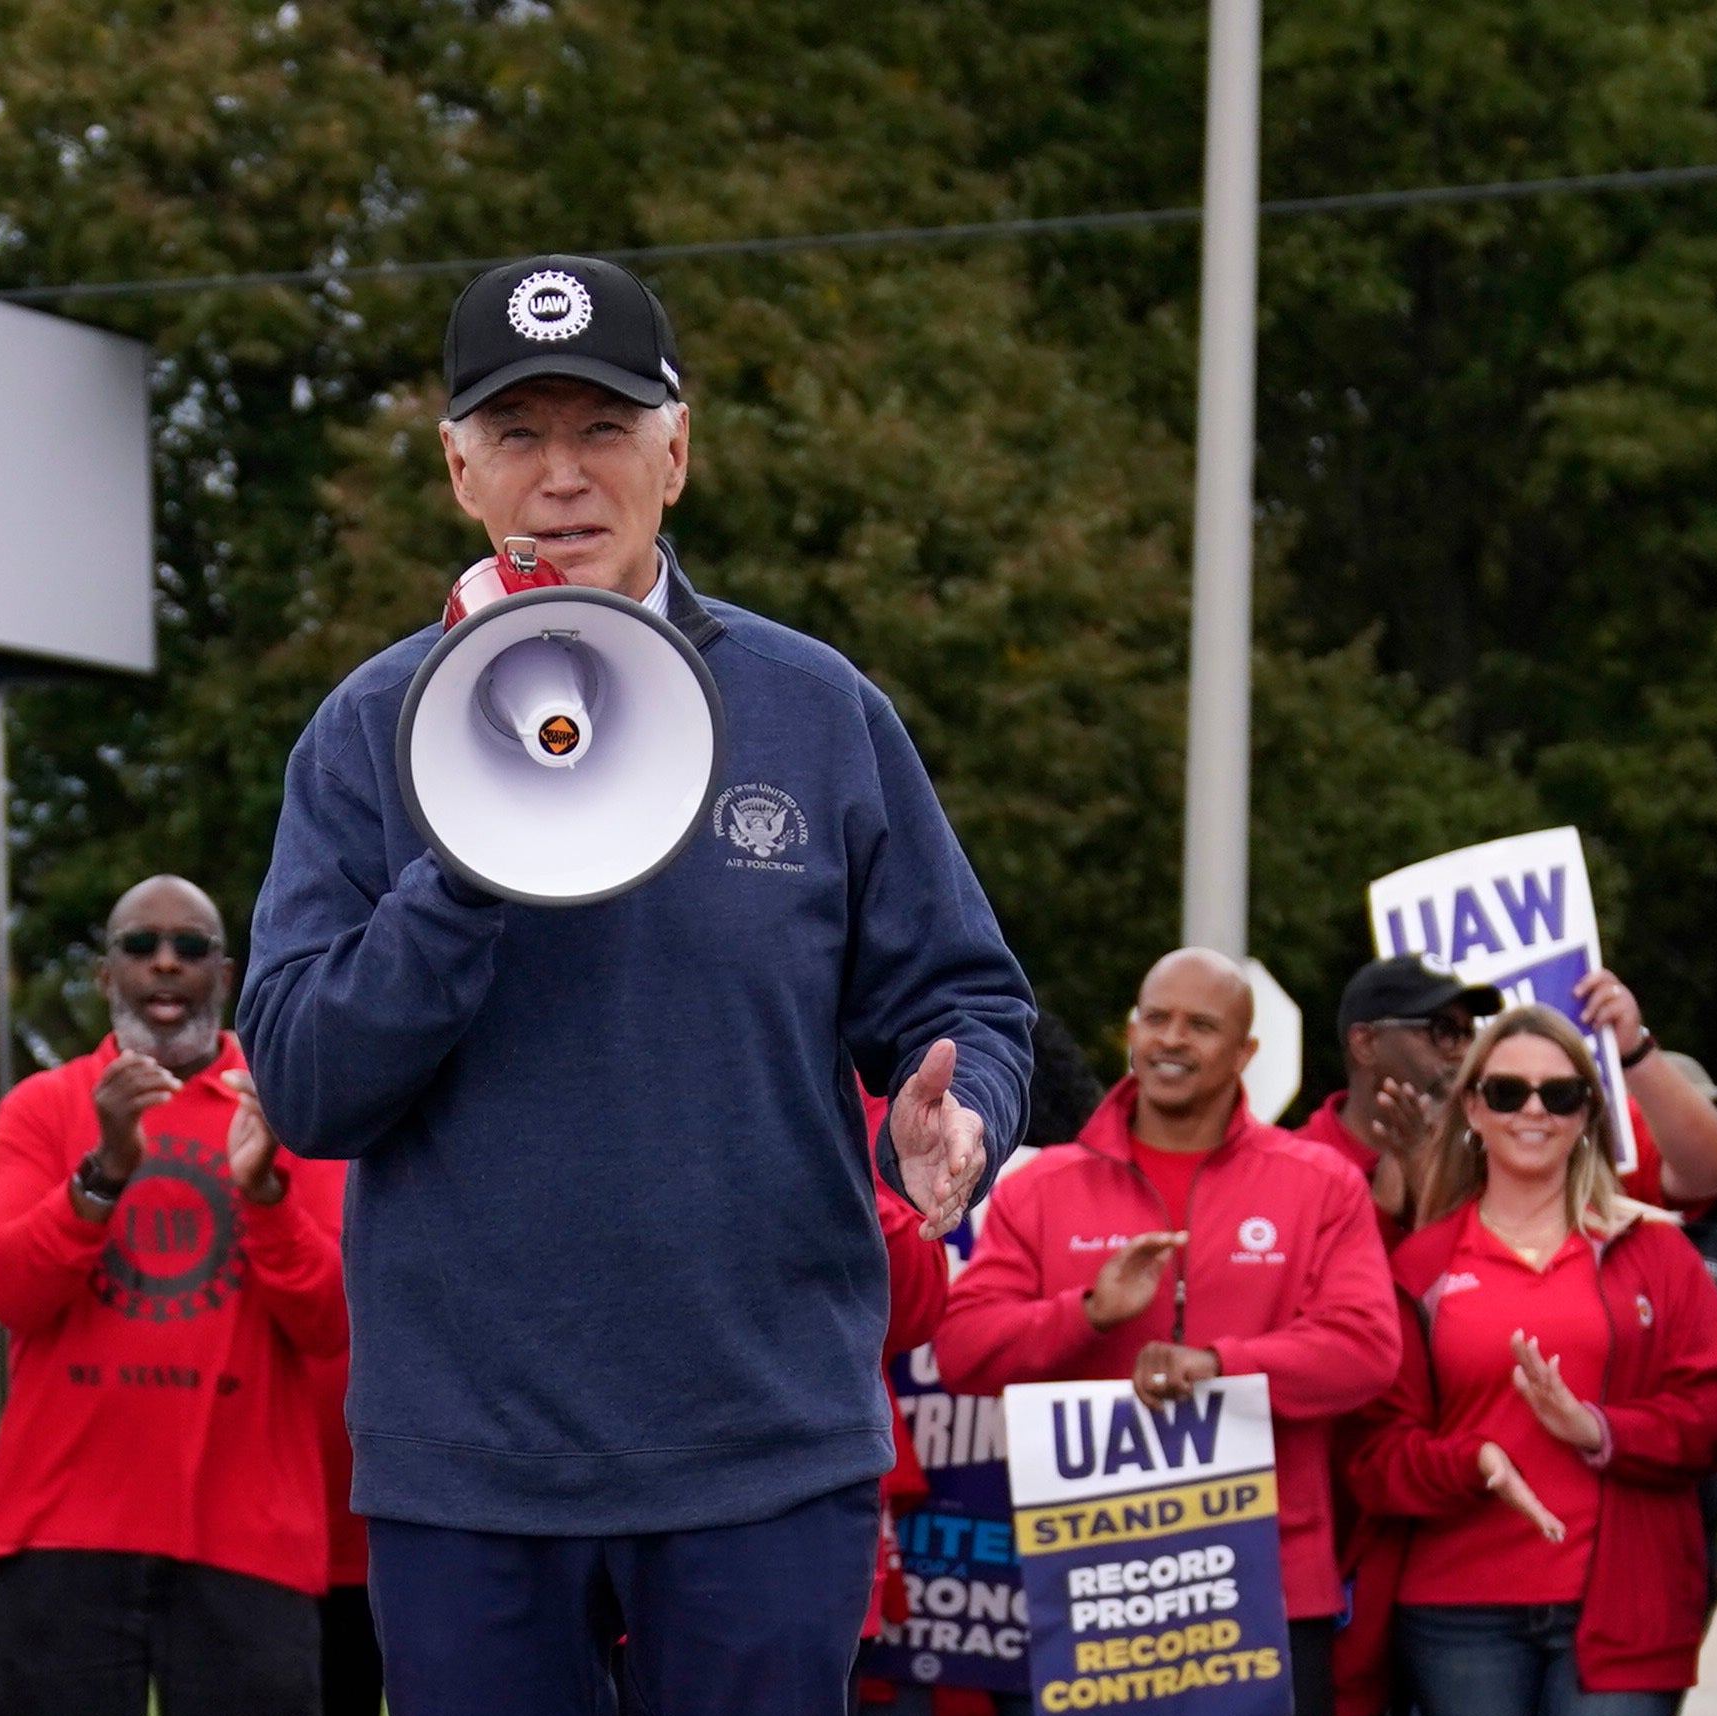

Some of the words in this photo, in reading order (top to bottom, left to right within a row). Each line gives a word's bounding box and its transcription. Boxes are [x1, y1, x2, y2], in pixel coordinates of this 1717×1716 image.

[530, 295, 571, 313] UAW
[712, 787, 734, 837] PRESIDENT
[758, 783, 798, 809] UNITED
[793, 807, 809, 846] STATES
[725, 858, 744, 868] AIR
[746, 859, 783, 871] FORCE
[783, 863, 806, 873] ONE
[1388, 865, 1567, 964] UAW
[125, 1204, 202, 1255] UAW
[118, 1364, 201, 1391] STAND
[1051, 1390, 1226, 1481] UAW
[1033, 1500, 1185, 1546] STAND
[1201, 1484, 1260, 1520] UP
[1068, 1544, 1237, 1598] RECORD
[1071, 1578, 1240, 1633] PROFITS
[1075, 1618, 1242, 1673] RECORD
[1041, 1646, 1282, 1714] CONTRACTS
